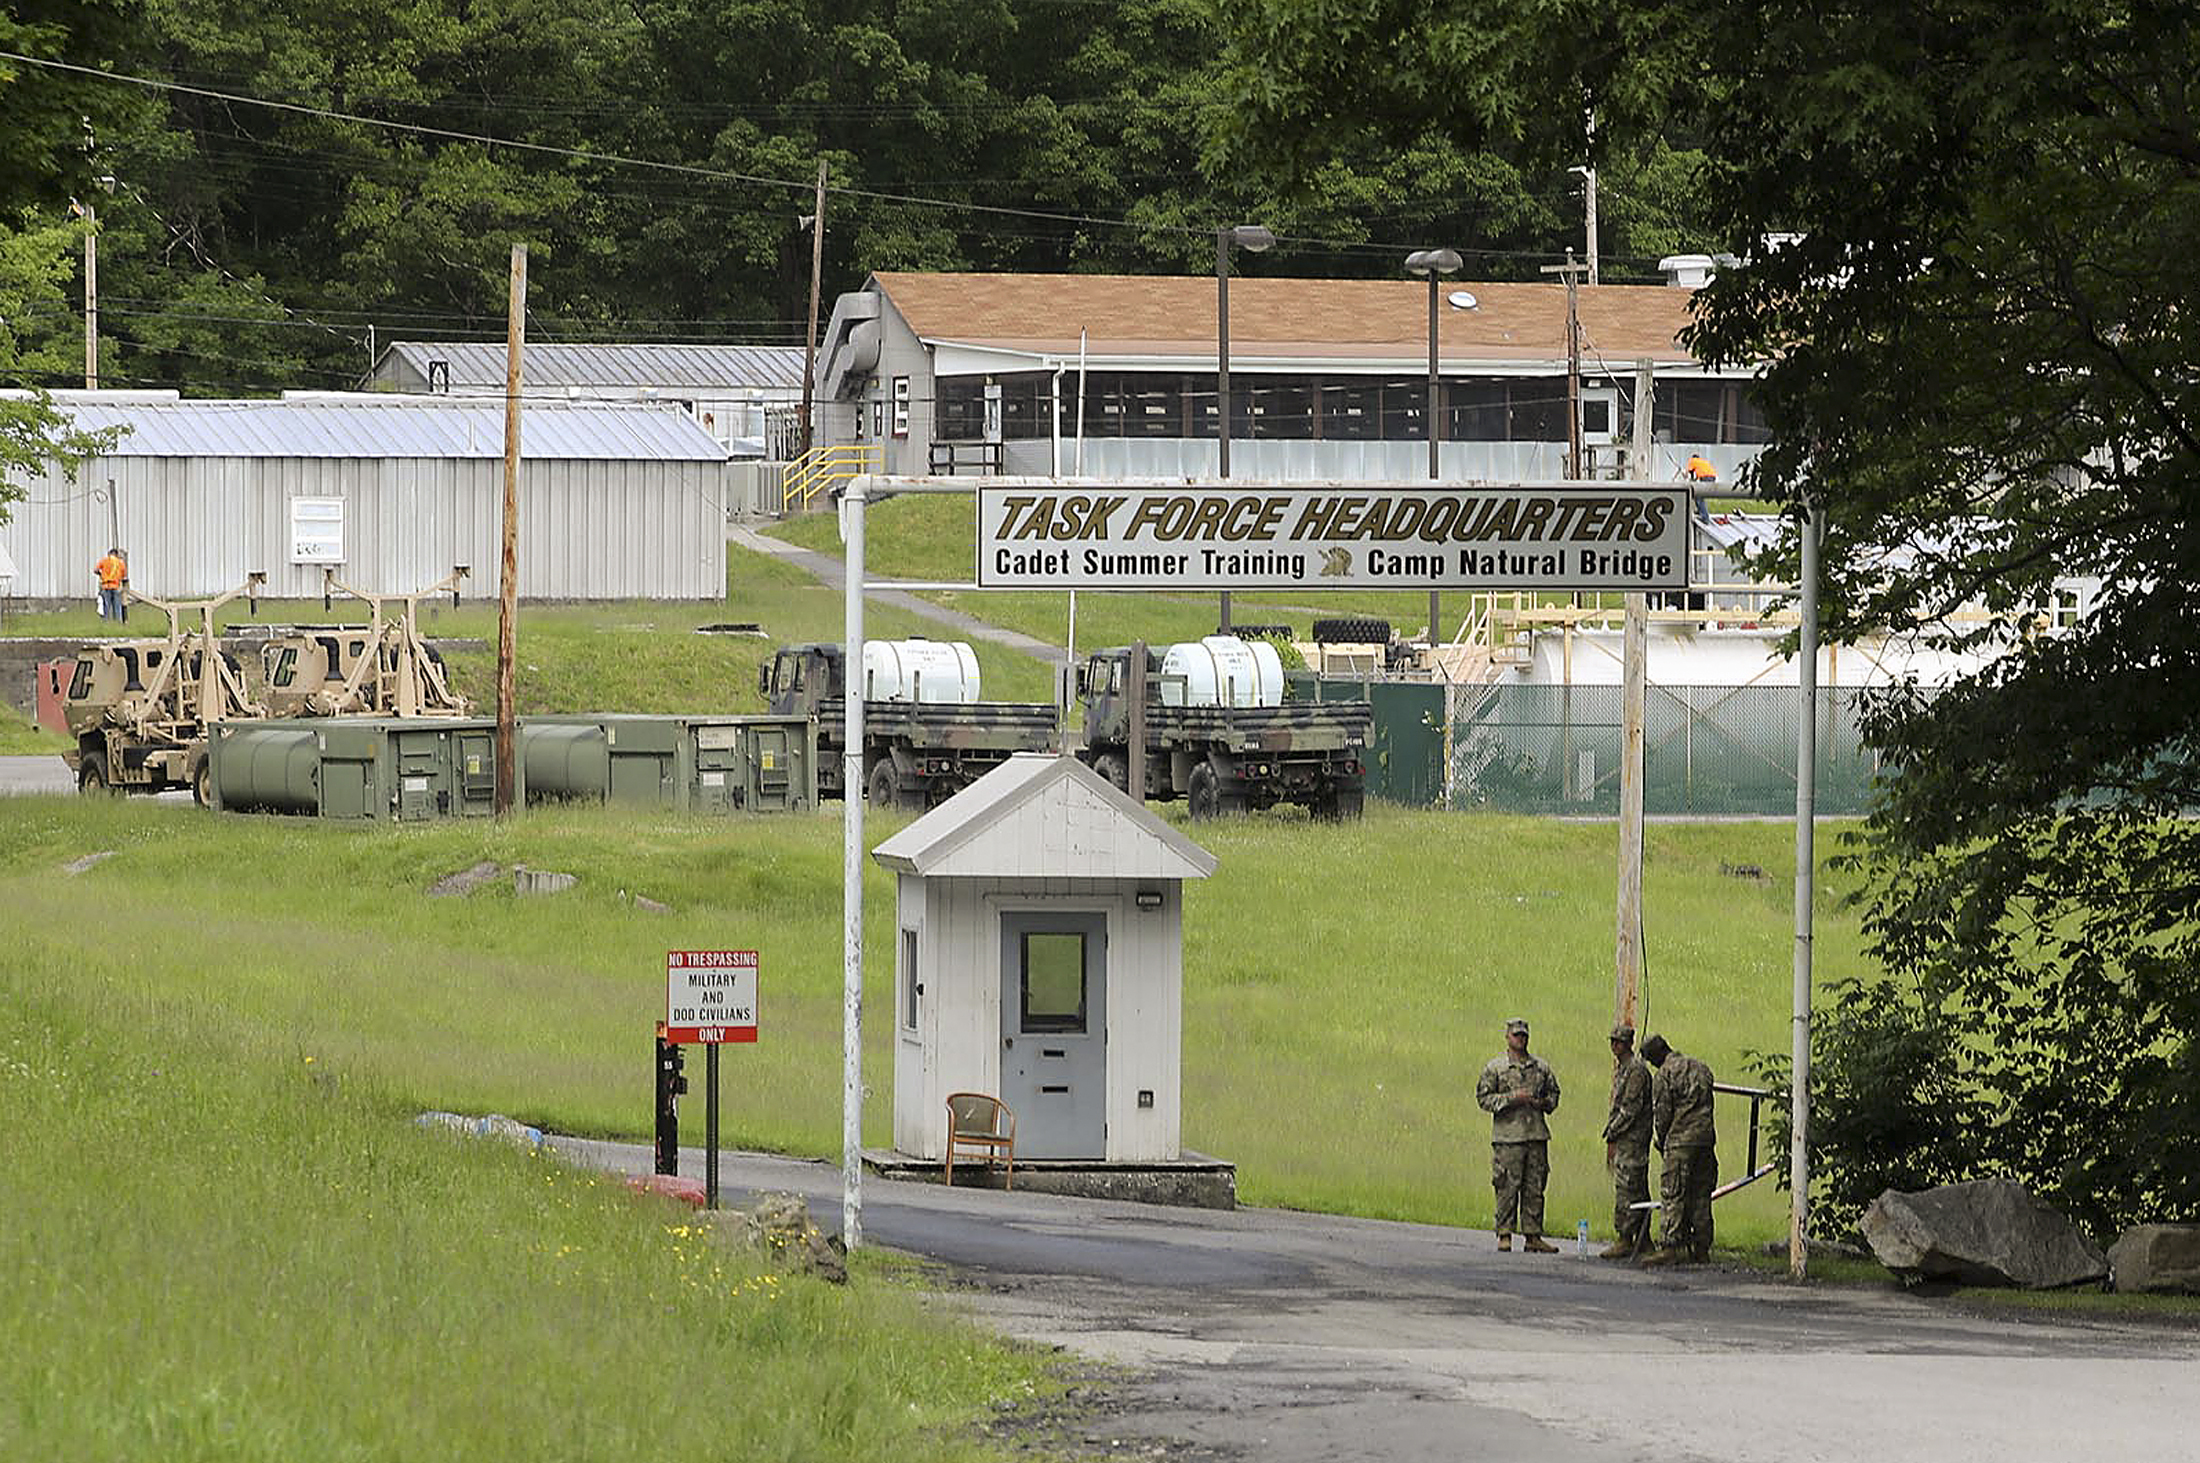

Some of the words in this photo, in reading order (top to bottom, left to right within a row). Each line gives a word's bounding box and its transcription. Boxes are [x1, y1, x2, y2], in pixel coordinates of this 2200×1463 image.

[995, 497, 1127, 541] TASK
[1123, 497, 1292, 541] FORCE
[1289, 497, 1675, 545] HEADQUARTERS
[996, 549, 1069, 575] Cadet
[1083, 549, 1189, 575] Summer
[1201, 549, 1306, 579] Training
[1368, 549, 1445, 579] Camp
[1460, 550, 1566, 576] Natural
[1580, 550, 1671, 579] Bridge
[669, 953, 683, 966] NO
[687, 953, 757, 966] TRESPASSING
[688, 974, 736, 987] MILITARY
[701, 991, 724, 1004] AND
[673, 1008, 695, 1021] DOD
[699, 1008, 750, 1021] CIVILIANS
[698, 1028, 726, 1042] ONLY
